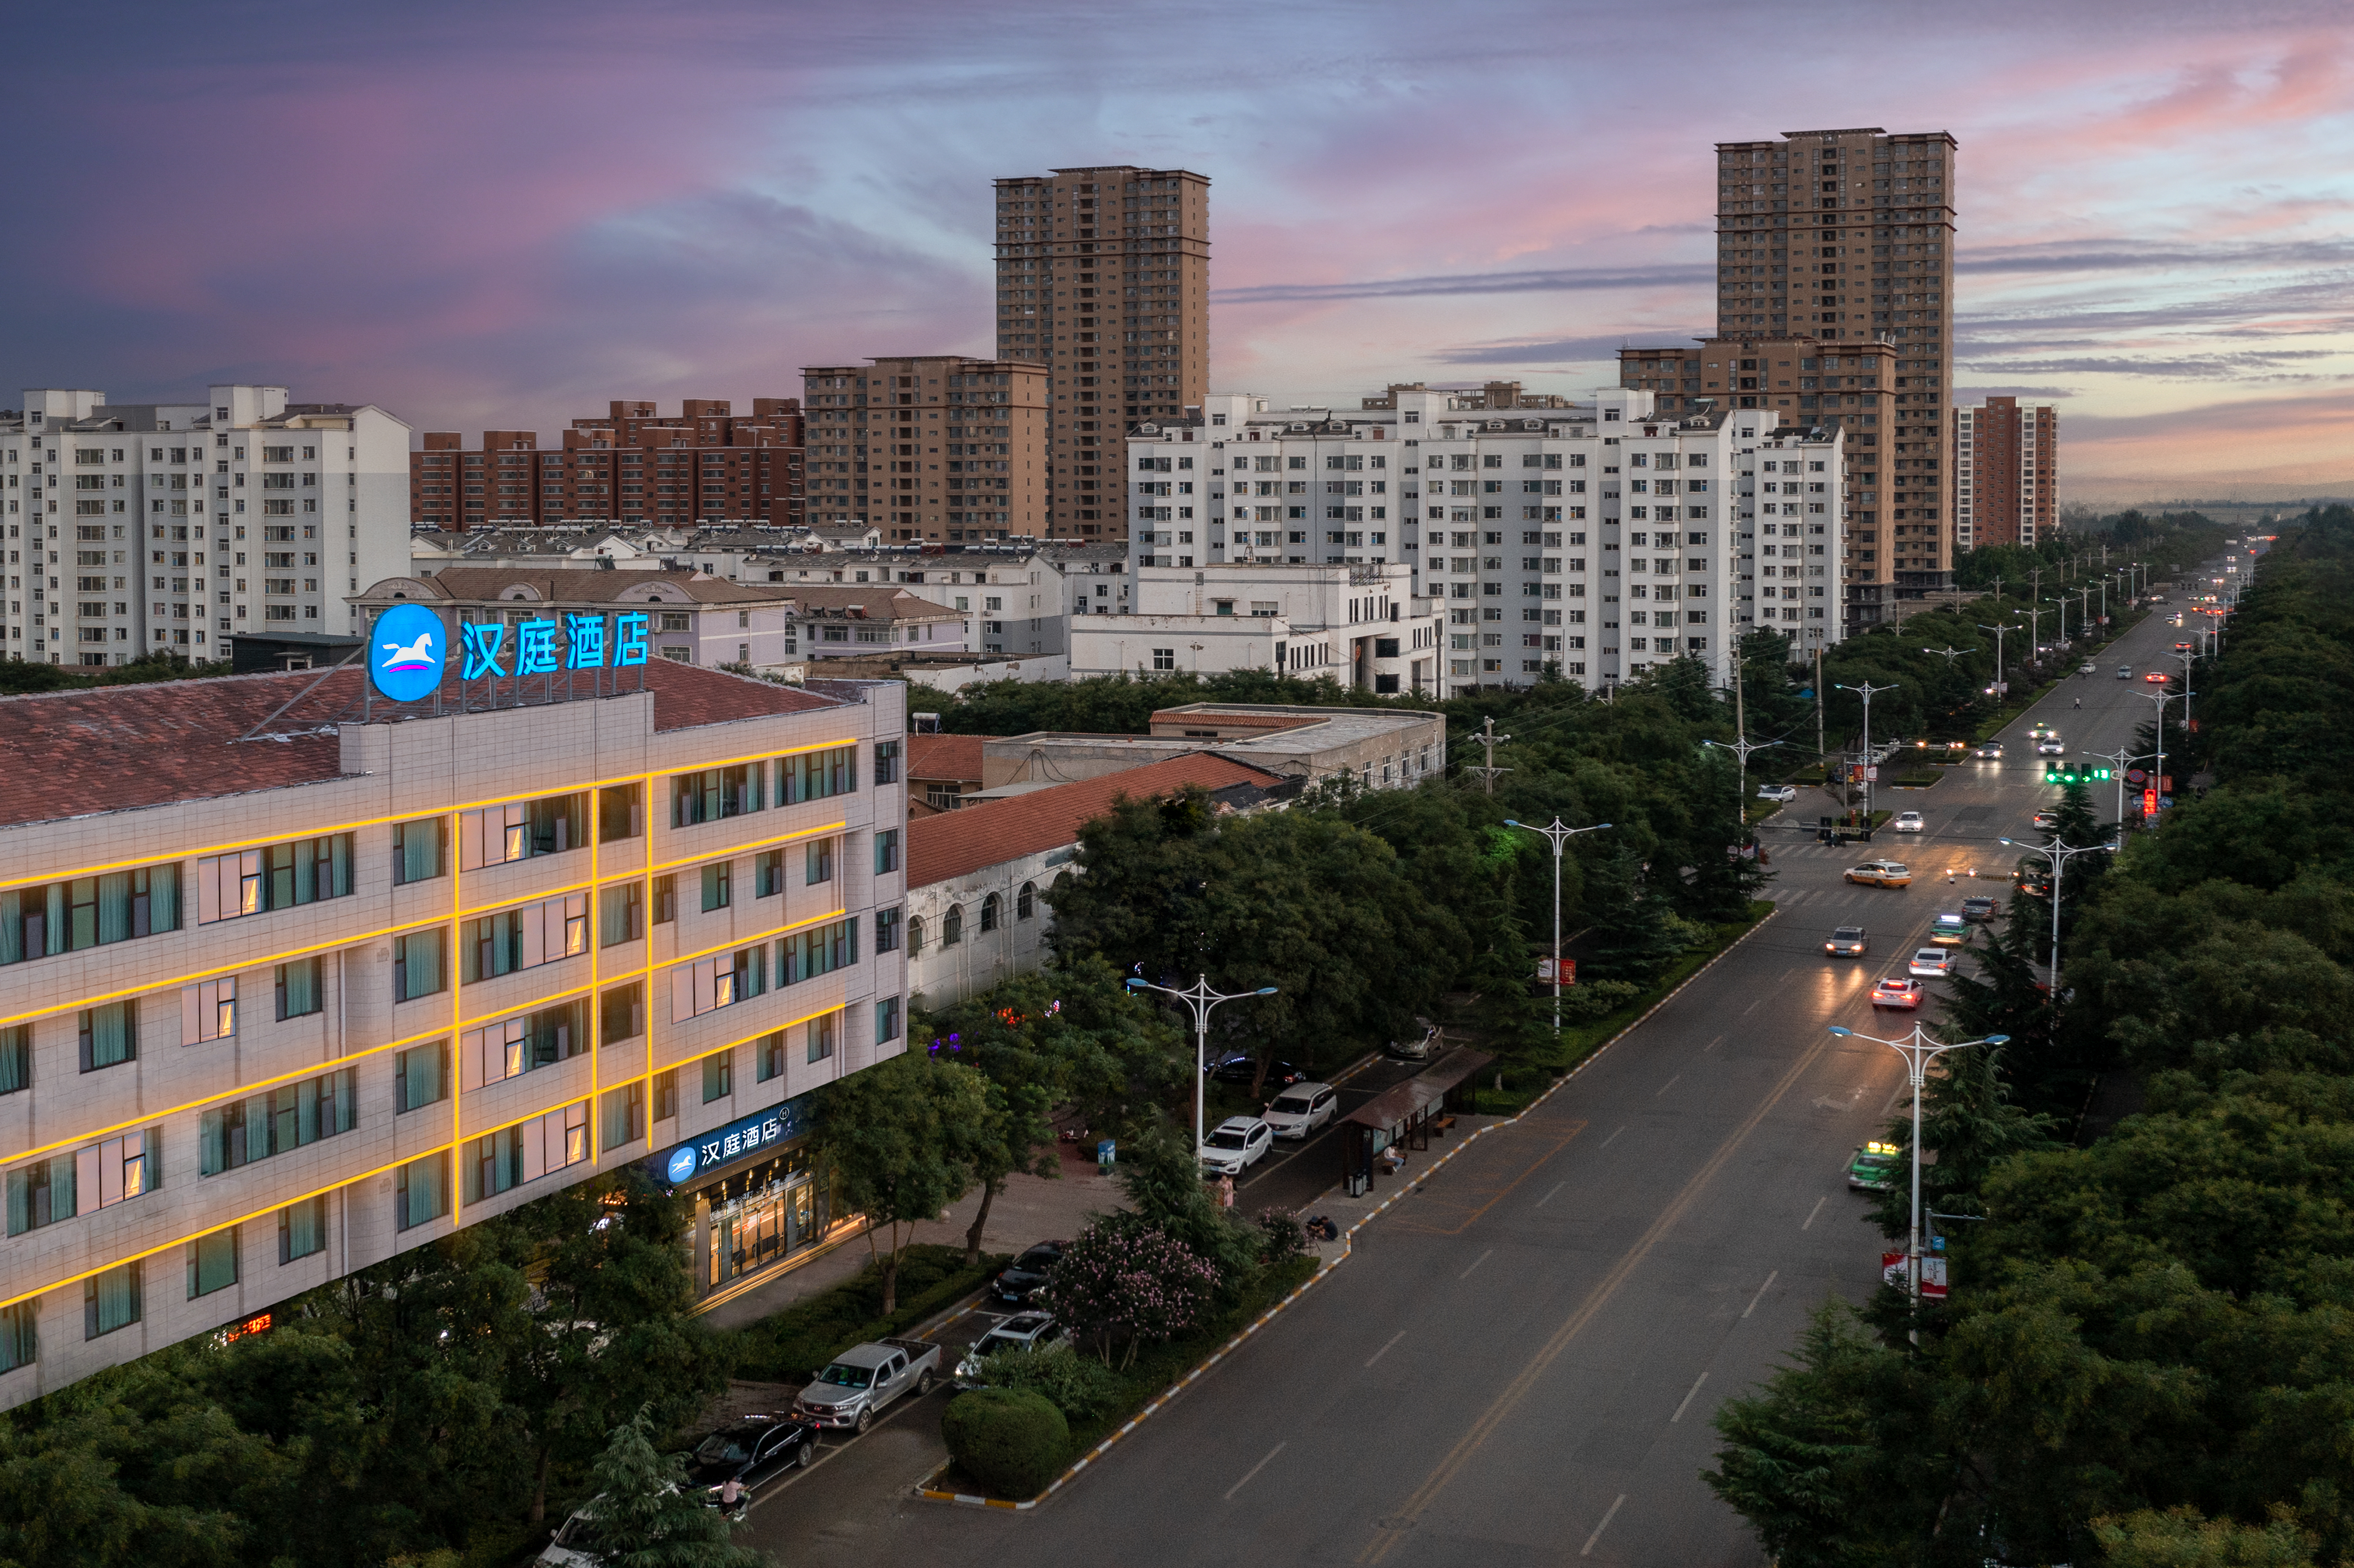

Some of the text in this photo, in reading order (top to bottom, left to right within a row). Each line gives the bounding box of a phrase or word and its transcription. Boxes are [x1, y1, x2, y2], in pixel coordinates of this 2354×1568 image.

[460, 611, 648, 680] 汉庭酒店
[701, 1117, 777, 1166] 汉庭酒店
